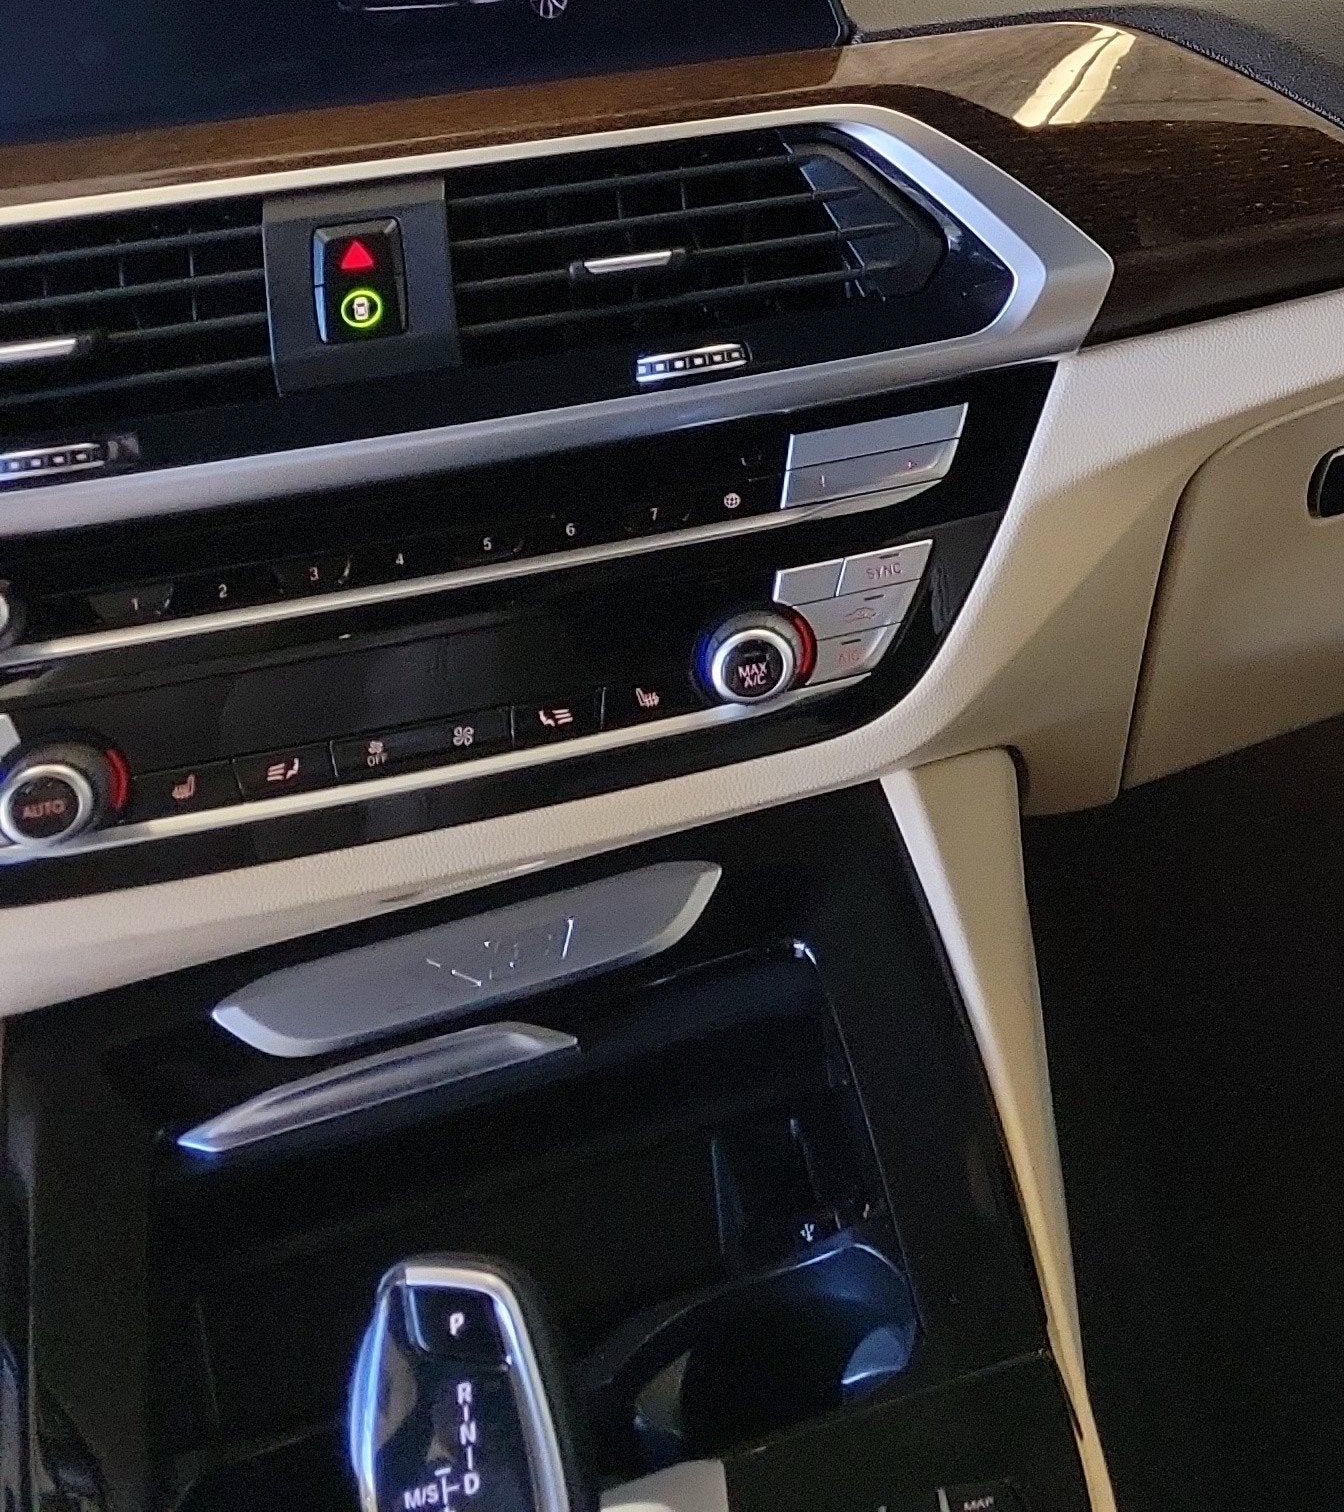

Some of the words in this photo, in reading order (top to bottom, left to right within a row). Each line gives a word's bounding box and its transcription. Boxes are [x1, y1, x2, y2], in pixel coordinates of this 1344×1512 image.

[218, 584, 228, 598] 2
[309, 566, 319, 581] 3
[395, 553, 405, 566] 4
[483, 537, 492, 551] 5
[565, 522, 576, 536] 6
[650, 507, 659, 521] 7
[866, 562, 903, 580] SYNC
[737, 661, 767, 679] MAX
[743, 672, 767, 689] A/C
[22, 799, 66, 819] AUTO
[449, 1311, 465, 1337] P
[456, 1381, 472, 1405] R
[459, 1420, 476, 1446] N
[403, 1482, 440, 1509] M/S
[463, 1471, 480, 1496] D
